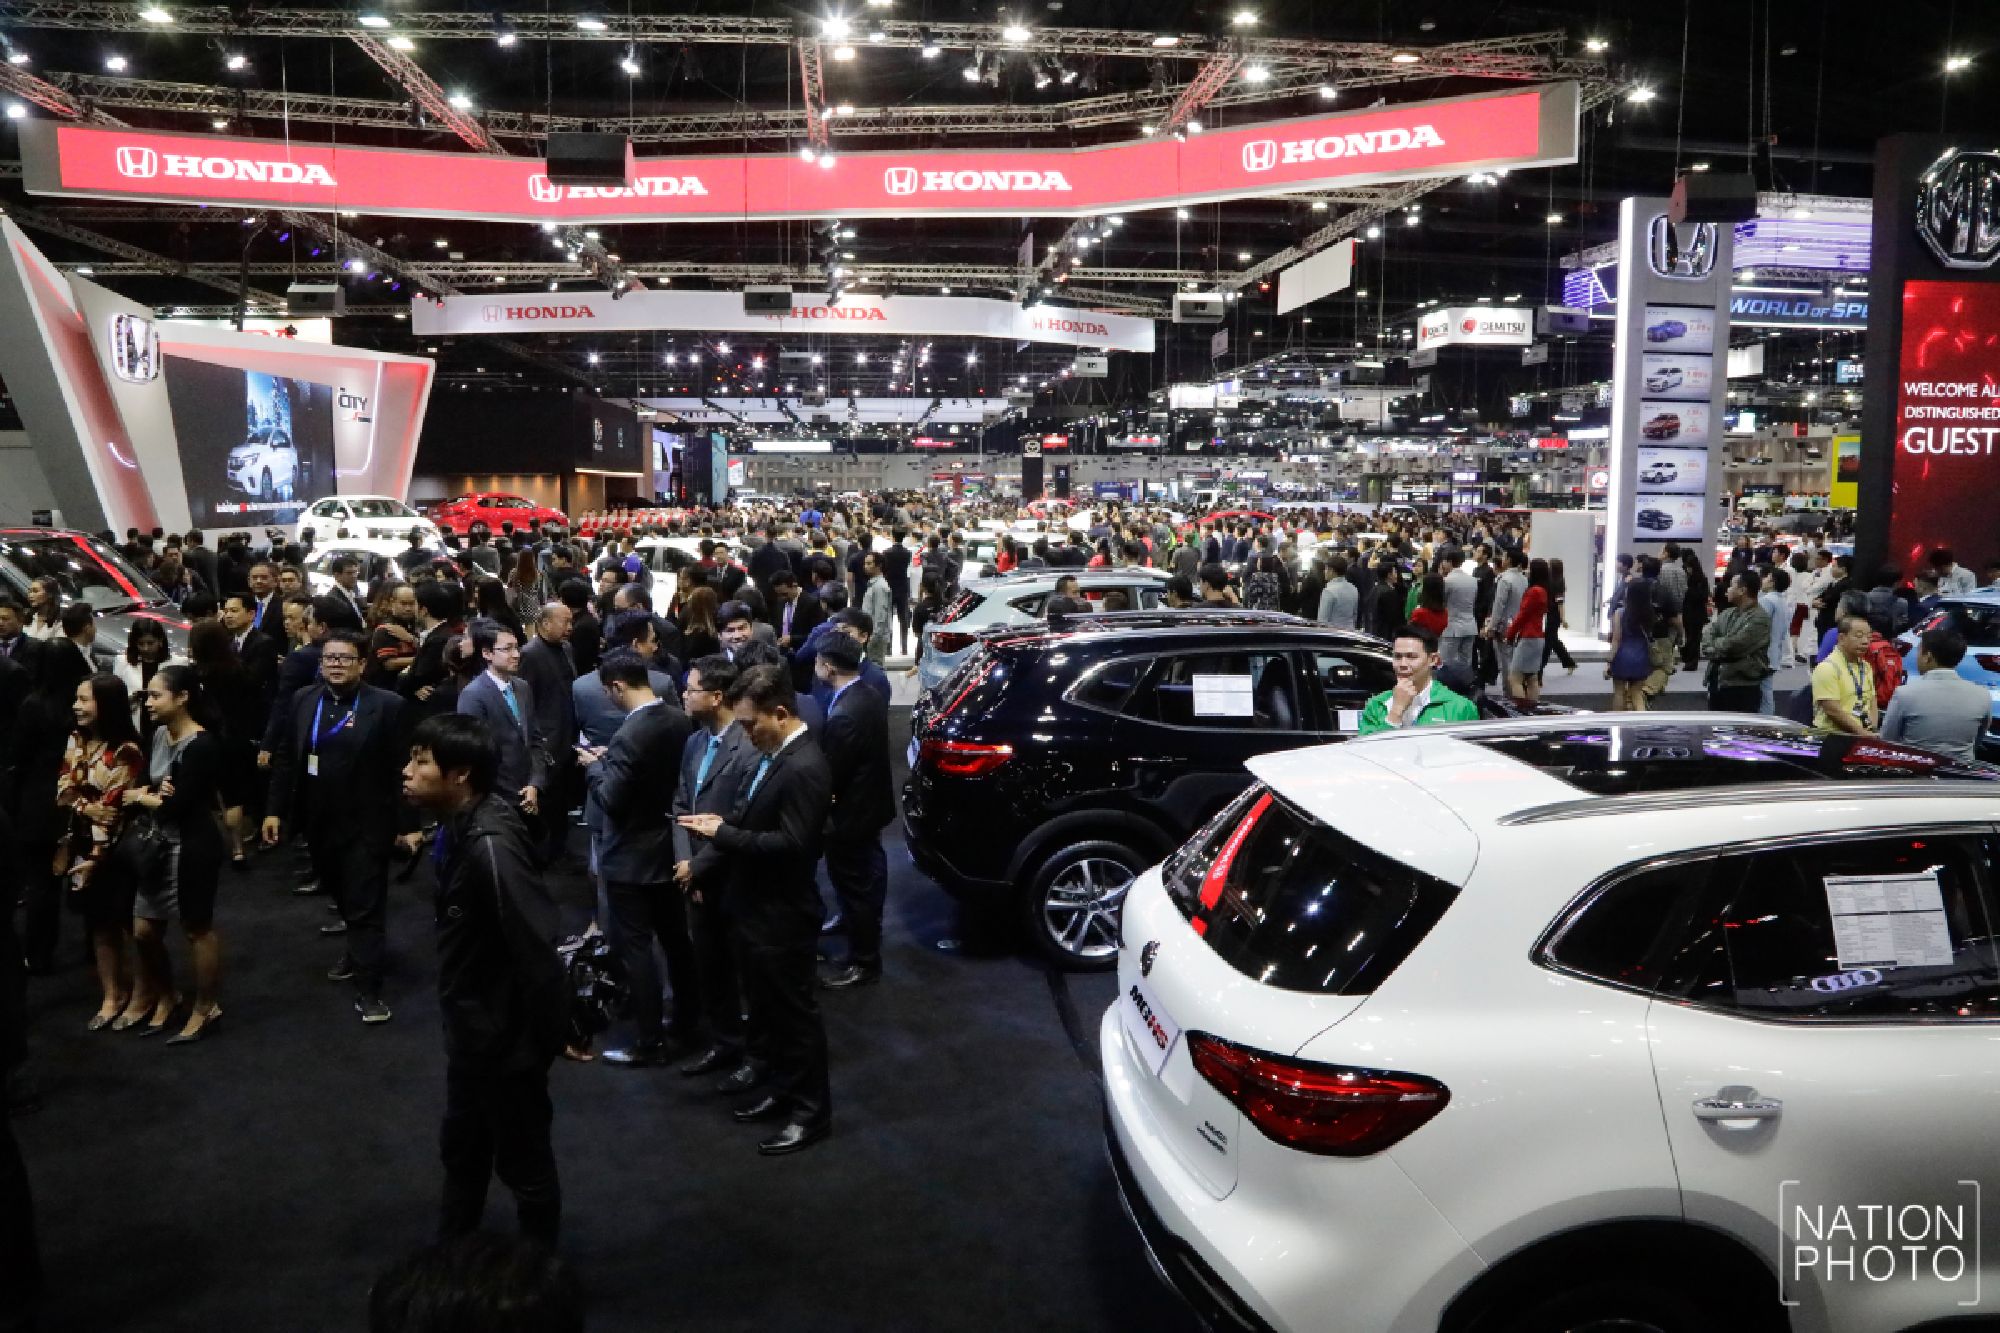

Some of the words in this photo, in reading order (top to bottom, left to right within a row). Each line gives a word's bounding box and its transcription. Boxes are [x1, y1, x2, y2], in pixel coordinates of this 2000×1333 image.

[1282, 125, 1445, 163] HONDA
[163, 154, 337, 186] HONDA
[922, 170, 1073, 192] HONDA
[505, 305, 595, 320] HONDA
[790, 306, 887, 321] HONDA
[1730, 298, 1810, 317] WORLD
[1811, 307, 1831, 318] OF
[1048, 318, 1108, 336] HONDA
[1904, 382, 1978, 397] WELCOME
[1980, 384, 2000, 398] AL
[1904, 406, 2000, 420] DISTINGUISHED
[1903, 426, 2000, 455] GUEST
